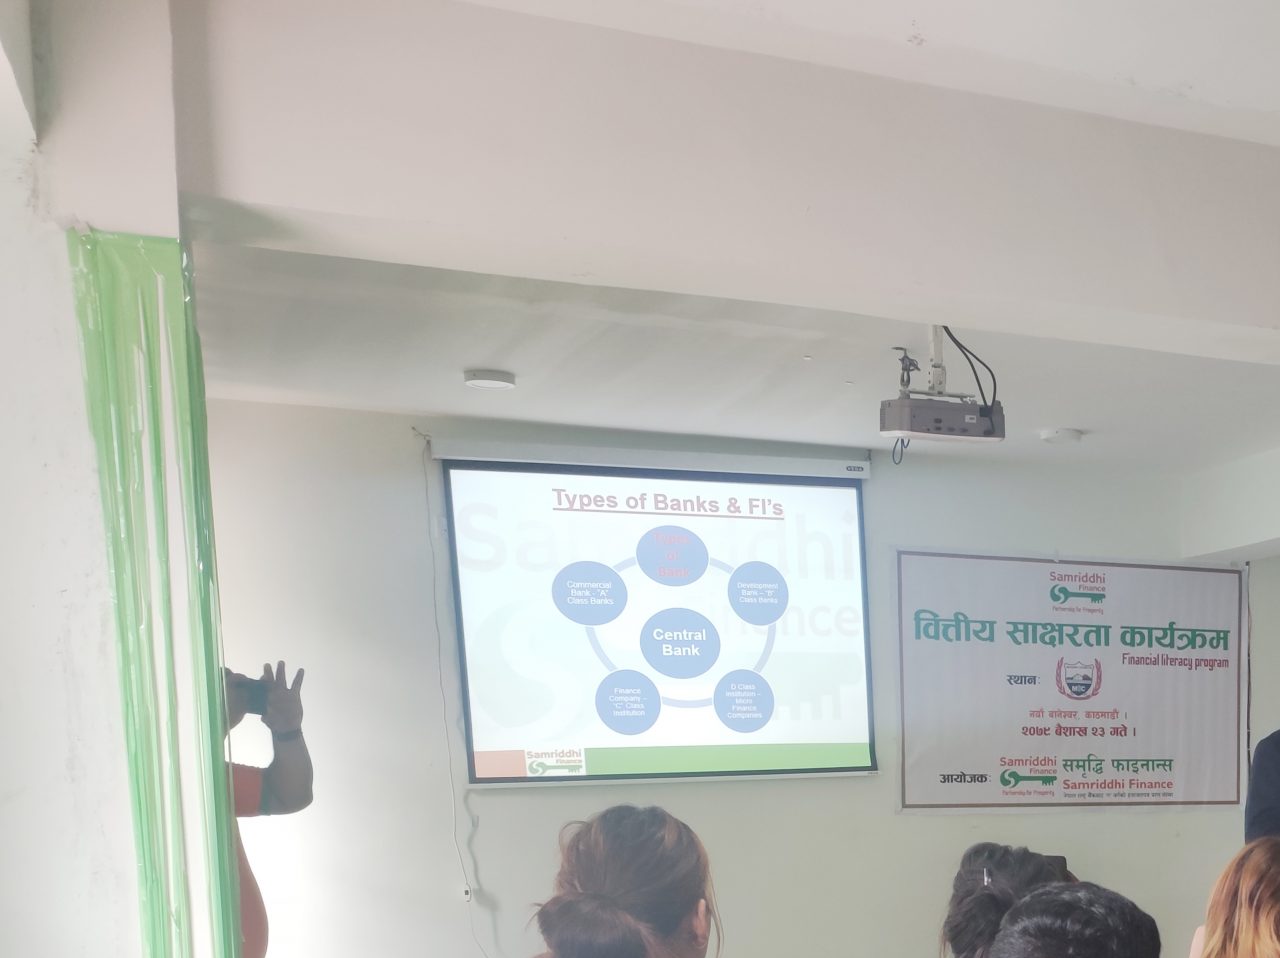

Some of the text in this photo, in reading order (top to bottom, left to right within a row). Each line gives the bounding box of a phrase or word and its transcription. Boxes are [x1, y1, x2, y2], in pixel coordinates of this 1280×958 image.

[552, 488, 618, 510] Types
[625, 493, 648, 510] of
[653, 493, 720, 513] Banks
[726, 497, 742, 514] &
[658, 566, 689, 577] Bank
[1049, 571, 1106, 584] Samriddhi
[566, 580, 612, 589] Commercial
[1078, 584, 1106, 592] Finance
[570, 588, 591, 597] Bank
[567, 597, 614, 605] Class Banks
[653, 628, 706, 641] Central
[914, 608, 1231, 651] वित्तीय साक्षरता कार्यक्रम
[662, 643, 701, 656] Bank
[1122, 652, 1229, 672] Financial literacy program
[526, 748, 582, 760] Samriddhi
[999, 755, 1057, 767] Samriddhi
[1062, 753, 1174, 778] समृद्धि फाइनान्स
[1062, 779, 1174, 790] Samriddhi Finance
